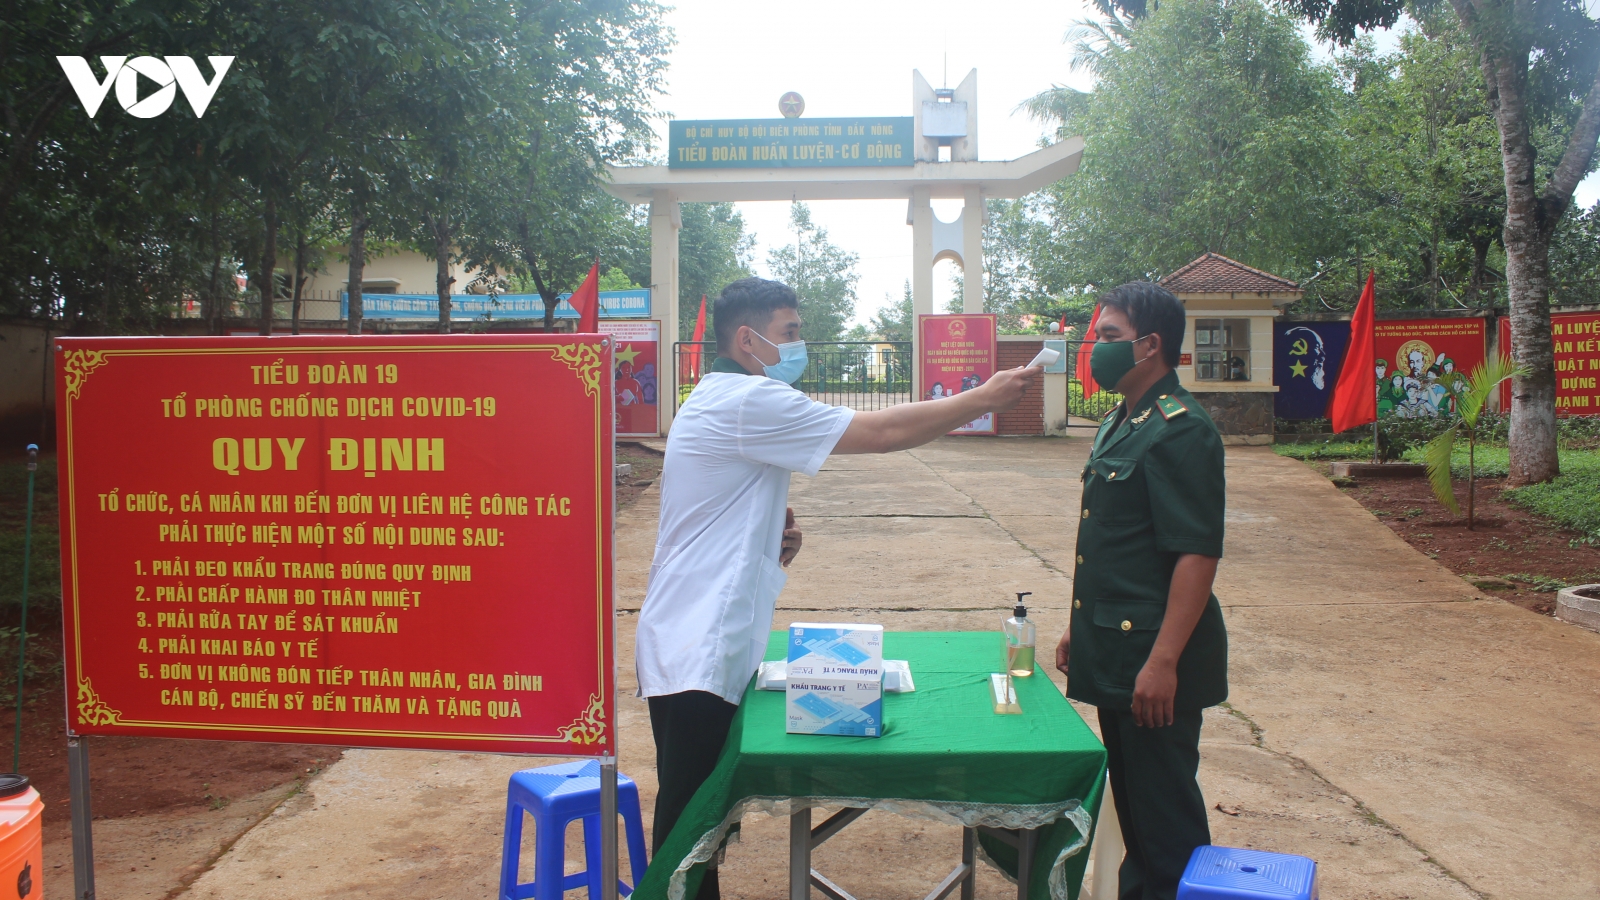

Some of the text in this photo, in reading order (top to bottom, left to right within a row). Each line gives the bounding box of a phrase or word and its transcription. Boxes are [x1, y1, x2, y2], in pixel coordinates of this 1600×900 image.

[686, 122, 893, 139] BỘ CHỈ HUY BỘ ĐỘI BIÊN PHÒNG TỈNH ĐẮK NÔNG
[678, 142, 706, 161] TIỂU
[712, 143, 747, 161] ĐOÀN
[752, 141, 788, 160] HUẤN
[867, 141, 902, 163] ĐỘNG
[604, 297, 620, 309] VIRUS
[622, 296, 645, 309] CORONA
[1567, 320, 1600, 336] LUYỆ
[1554, 340, 1572, 353] ÀN
[251, 358, 398, 384] TIỂU ĐOÀN 19
[1562, 376, 1596, 391] DỰNG
[161, 392, 496, 420] TỔ PHÒNG CHỐNG DỊCH COVID-19
[212, 437, 445, 478] QUY ĐỊNH
[98, 488, 571, 519] TỔ CHỨC, CÁ NHÂN KHI ĐẾN ĐƠN VỊ LIÊN HỆ CÔNG TÁC
[159, 520, 504, 549] PHẢI THỰC HIỆN MỘT SỐ NỘI DUNG SAU:
[134, 556, 471, 584] 1. PHẢI ĐEO KHẨU TRANG ĐÚNG QUY ĐỊNH
[135, 581, 421, 610] 2. PHẢI CHẤP HÀNH ĐO THÂN NHIỆT
[136, 608, 398, 634] 3. PHẢI RỬA TAY ĐỂ SÁT KHUẨN
[138, 634, 319, 658] 4. PHẢI KHAI BÁO Y TẾ
[138, 662, 543, 692] 5. ĐƠN VỊ KHÔNG ĐÓN TIẾP THÂN NHÂN, GIA ĐÌNH
[161, 687, 522, 720] CÁN BỘ, CHIẾN SỸ ĐẾN THĂM VÀ TẶNG QUÀ
